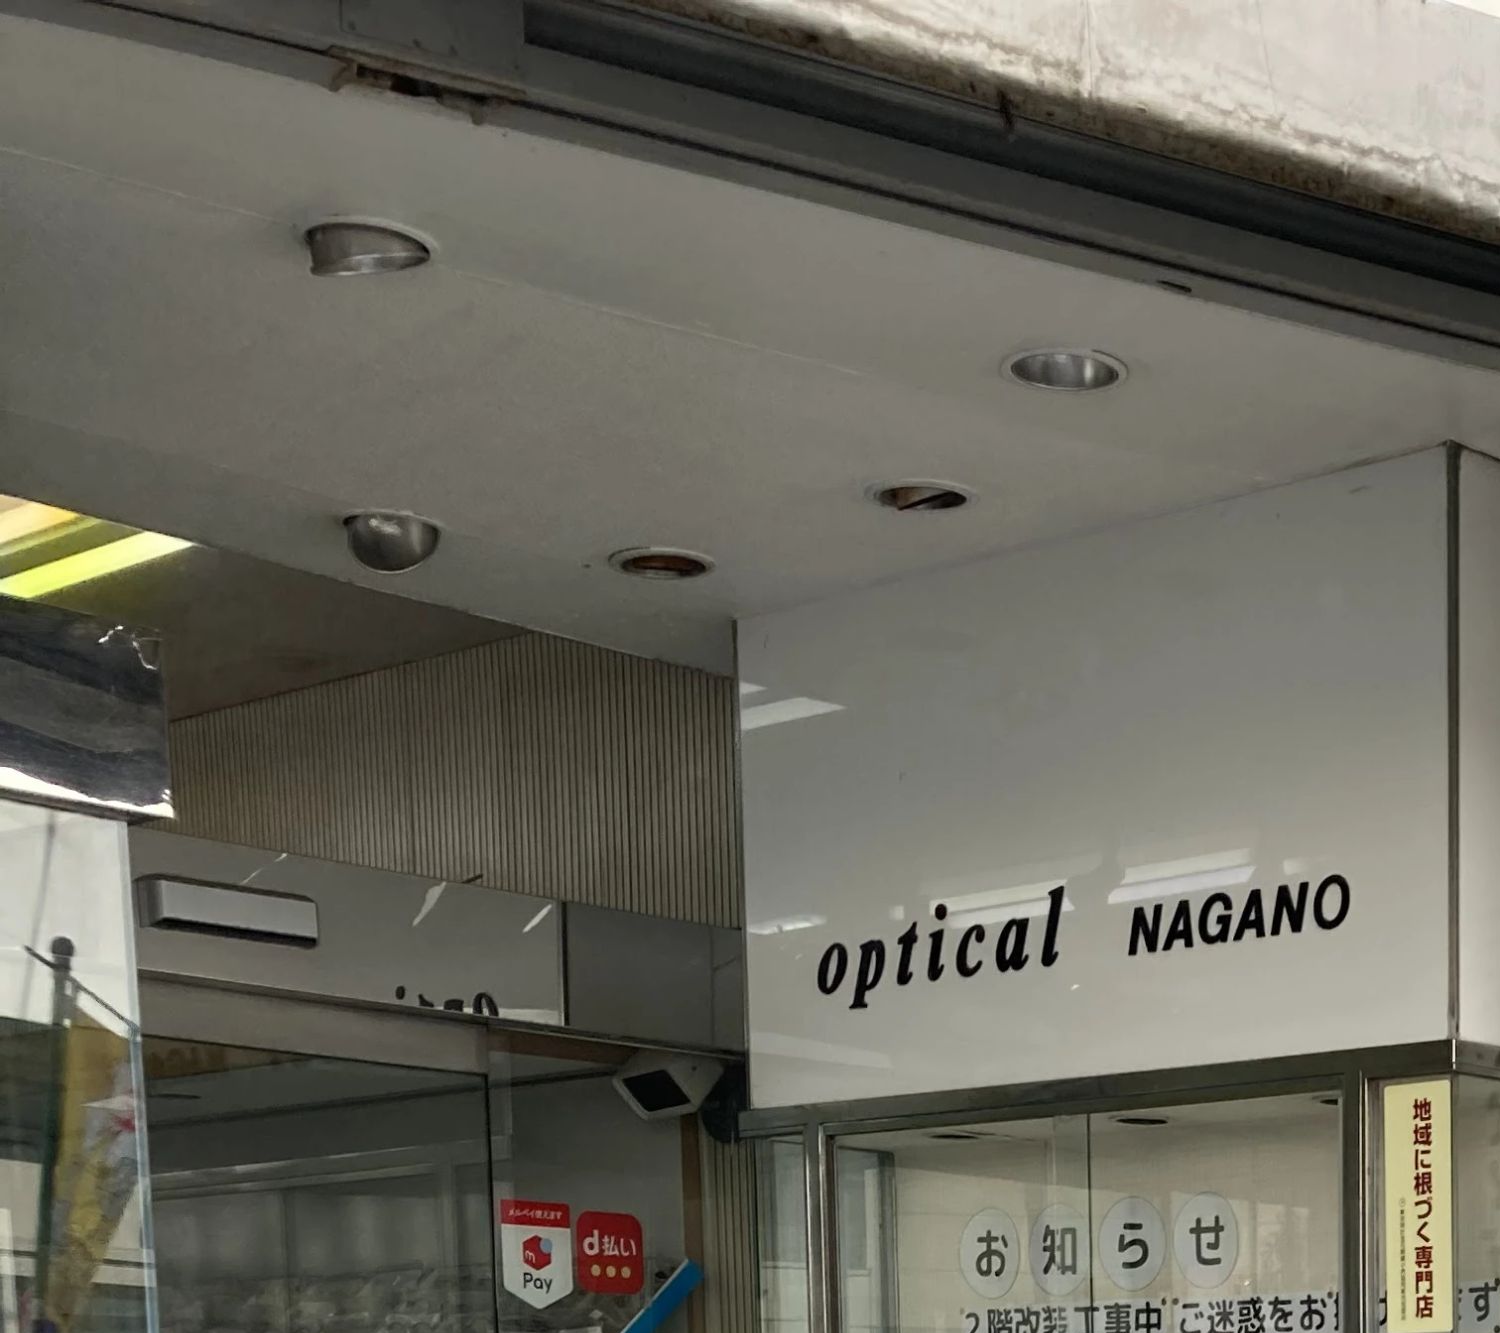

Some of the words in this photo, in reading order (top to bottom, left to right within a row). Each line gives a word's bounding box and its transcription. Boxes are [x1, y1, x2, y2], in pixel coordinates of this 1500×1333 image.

[817, 885, 1064, 1009] optical
[1128, 874, 1350, 956] NAGANO
[1412, 1097, 1434, 1320] 地域に根づく専門店
[583, 1229, 633, 1257] d払い
[975, 1213, 1226, 1278] お知らせ
[523, 1272, 553, 1294] Pay
